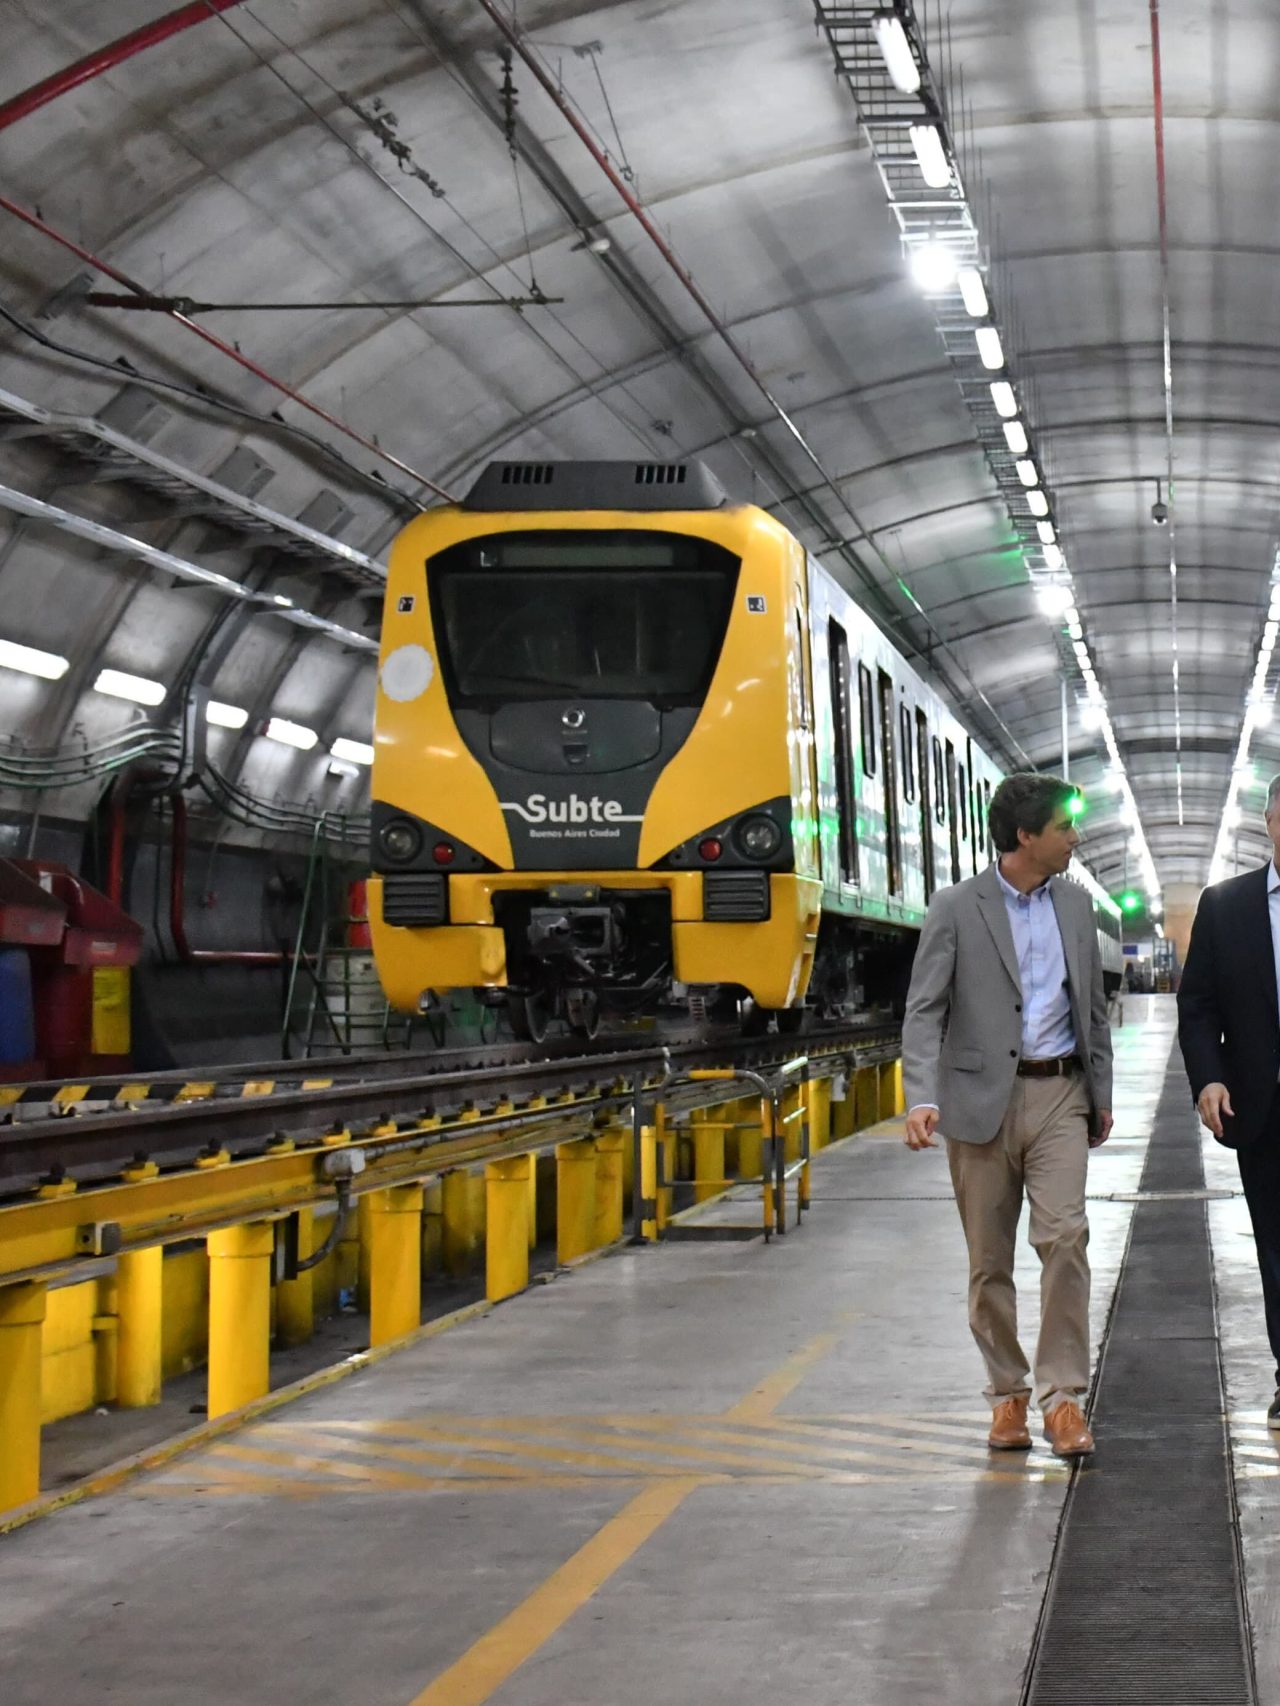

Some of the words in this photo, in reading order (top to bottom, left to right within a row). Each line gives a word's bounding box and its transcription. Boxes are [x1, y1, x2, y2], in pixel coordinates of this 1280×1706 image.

[526, 793, 623, 823] Subte
[529, 829, 562, 838] Buenos
[564, 829, 587, 838] Aires
